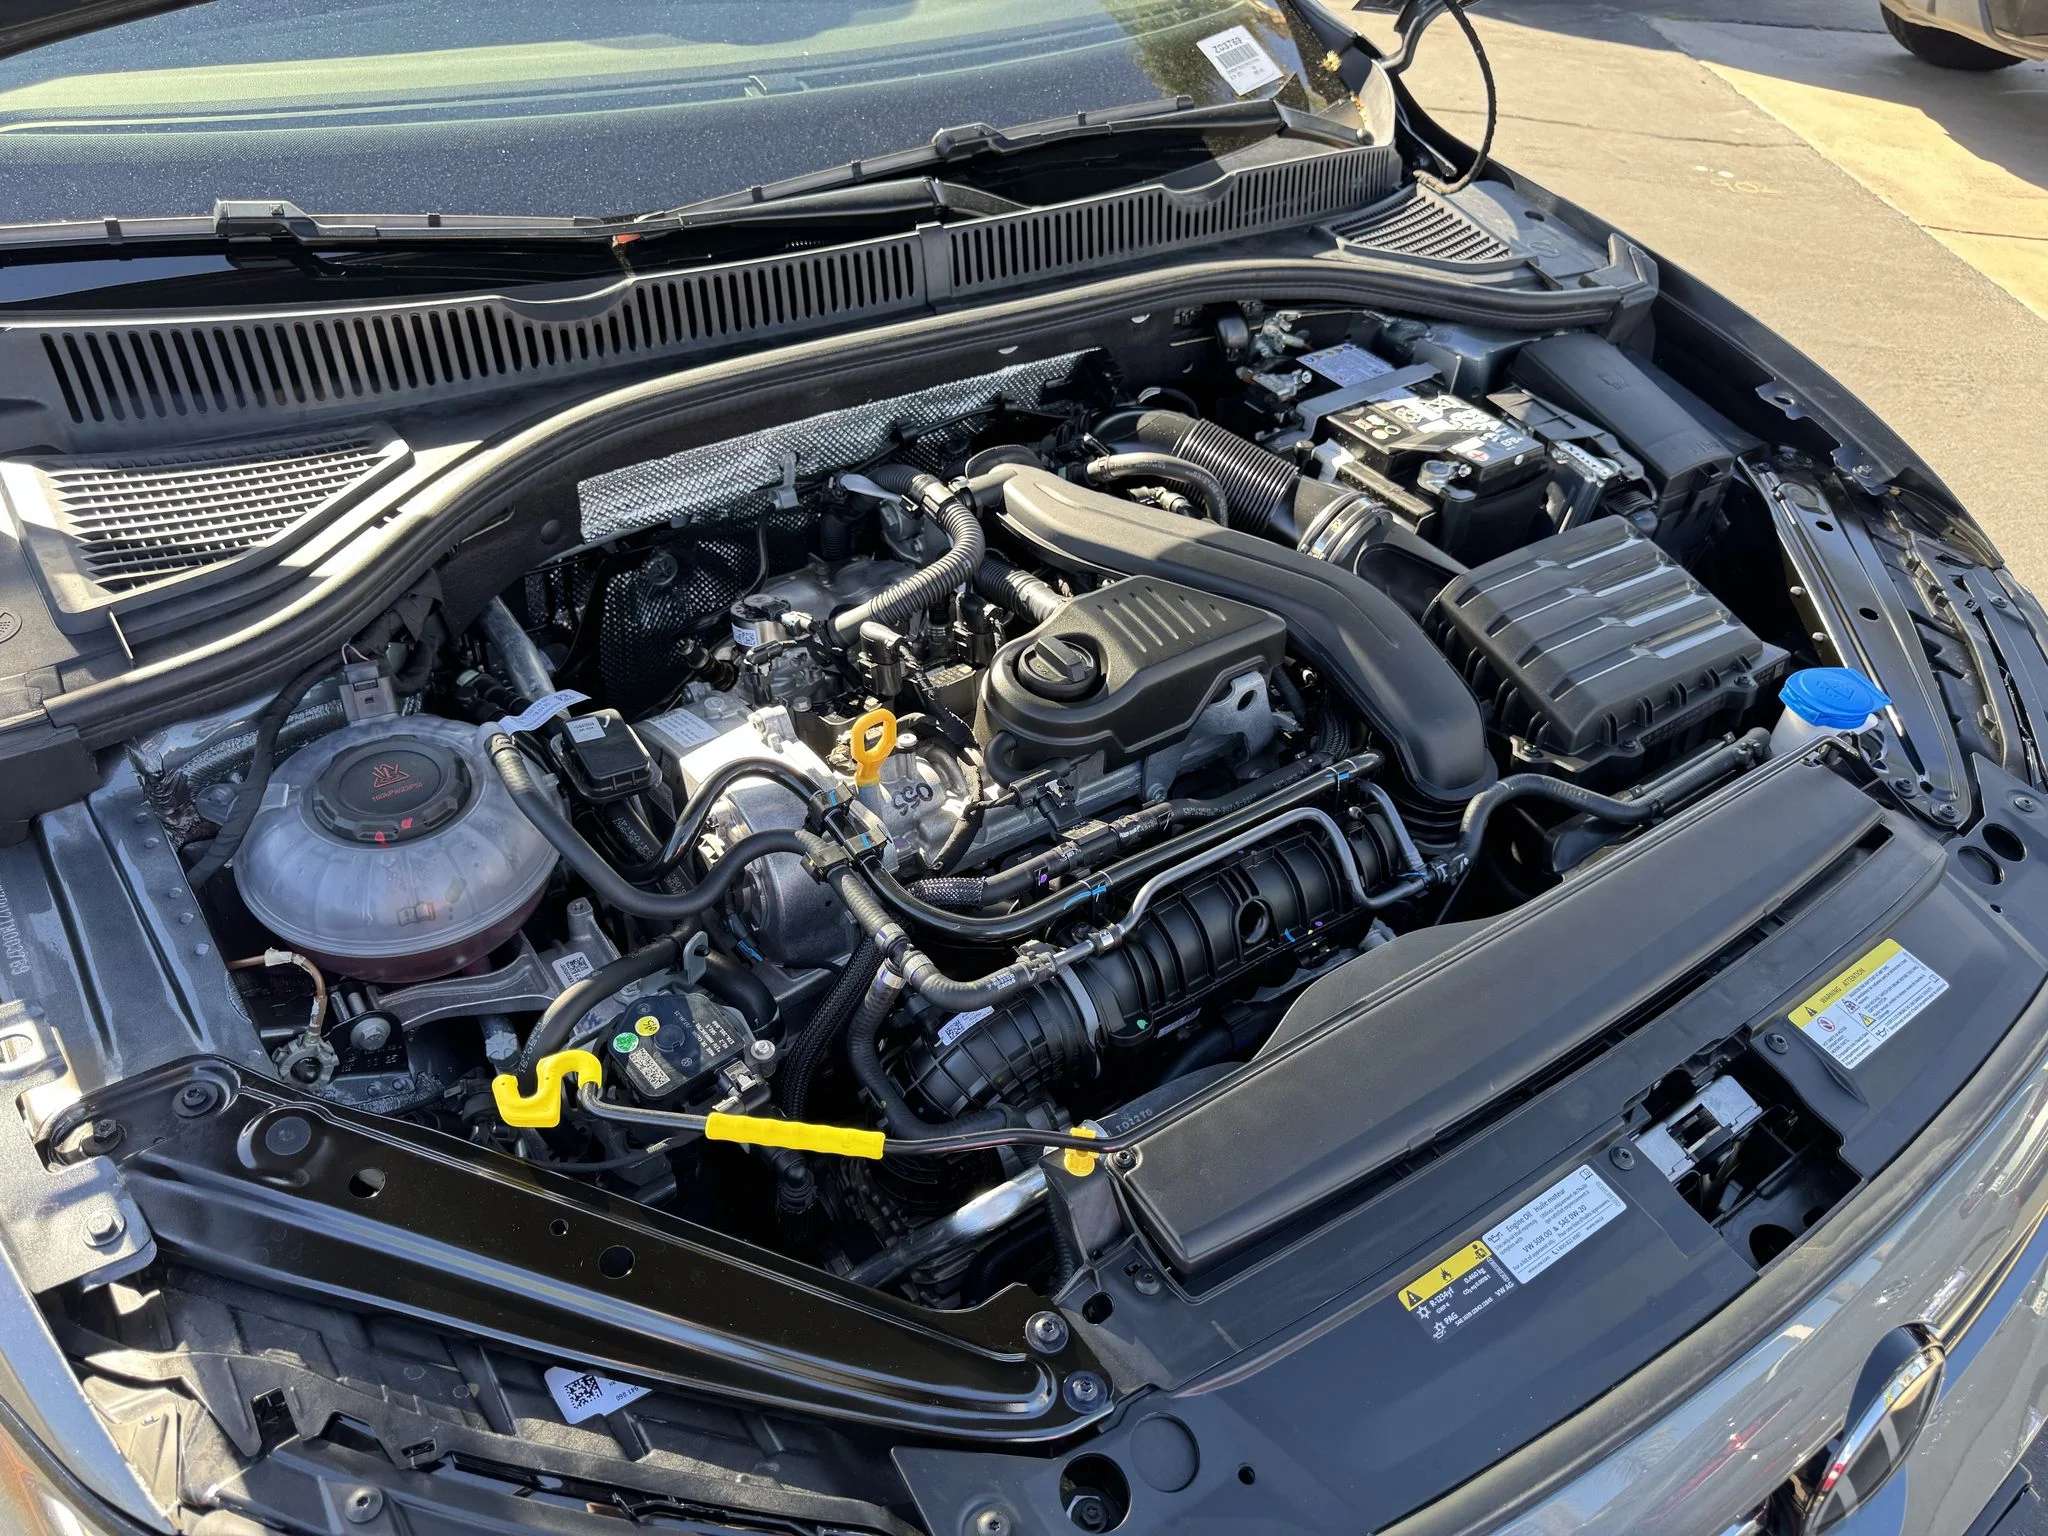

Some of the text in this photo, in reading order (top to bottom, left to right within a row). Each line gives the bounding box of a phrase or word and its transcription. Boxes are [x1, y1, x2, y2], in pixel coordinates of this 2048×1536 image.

[1819, 986, 1842, 1004] WARNING
[1841, 967, 1866, 987] ATTENTION
[1533, 1188, 1566, 1212] Huile moteur
[1505, 1211, 1533, 1233] Engine Oil
[1523, 1242, 1535, 1253] VW
[1533, 1235, 1545, 1245] 508
[1543, 1229, 1553, 1238] 00
[1558, 1217, 1570, 1227] SAE
[1568, 1204, 1587, 1220] 0W-20
[1429, 1287, 1457, 1309] R-1234yf
[1495, 1281, 1515, 1297] VW AG
[1443, 1312, 1459, 1324] PAG
